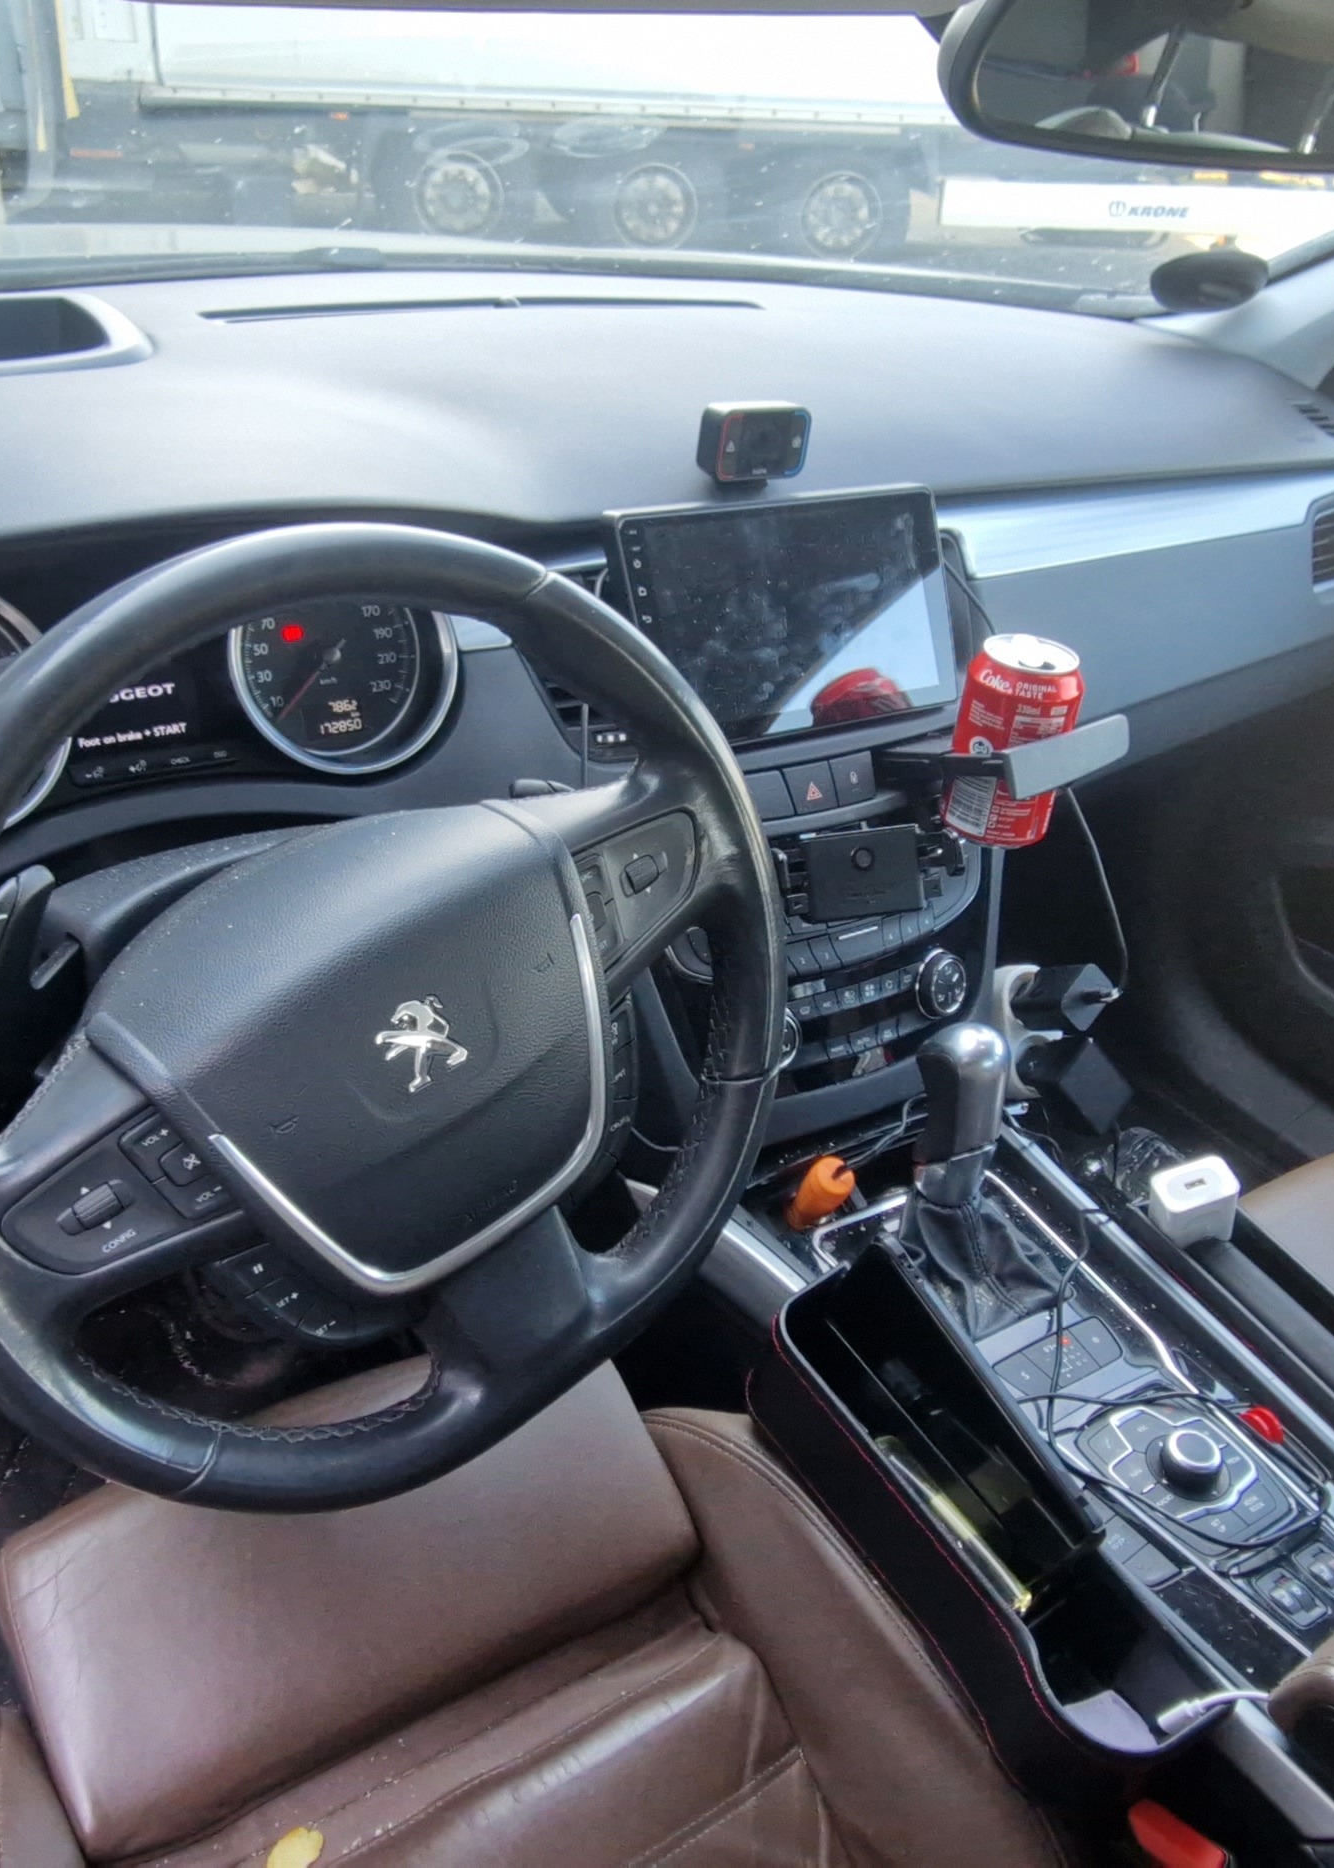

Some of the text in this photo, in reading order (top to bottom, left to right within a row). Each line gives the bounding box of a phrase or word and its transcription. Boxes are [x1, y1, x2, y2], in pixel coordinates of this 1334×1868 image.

[1127, 205, 1191, 219] KRONE
[361, 605, 380, 619] 170
[261, 617, 275, 630] 70
[373, 626, 393, 640] 190
[253, 643, 269, 657] 50
[256, 669, 273, 684] 30
[979, 668, 1011, 694] Coke
[110, 682, 175, 703] GEOT
[369, 679, 392, 694] 230
[1016, 681, 1058, 694] ORIGINAL
[1014, 688, 1044, 700] TASTE
[270, 695, 284, 708] 10
[328, 699, 359, 713] 7862
[319, 717, 363, 735] 172850
[78, 736, 102, 749] Foot
[117, 729, 144, 743] brake
[152, 721, 188, 737] START
[102, 1228, 138, 1254] CONFIG
